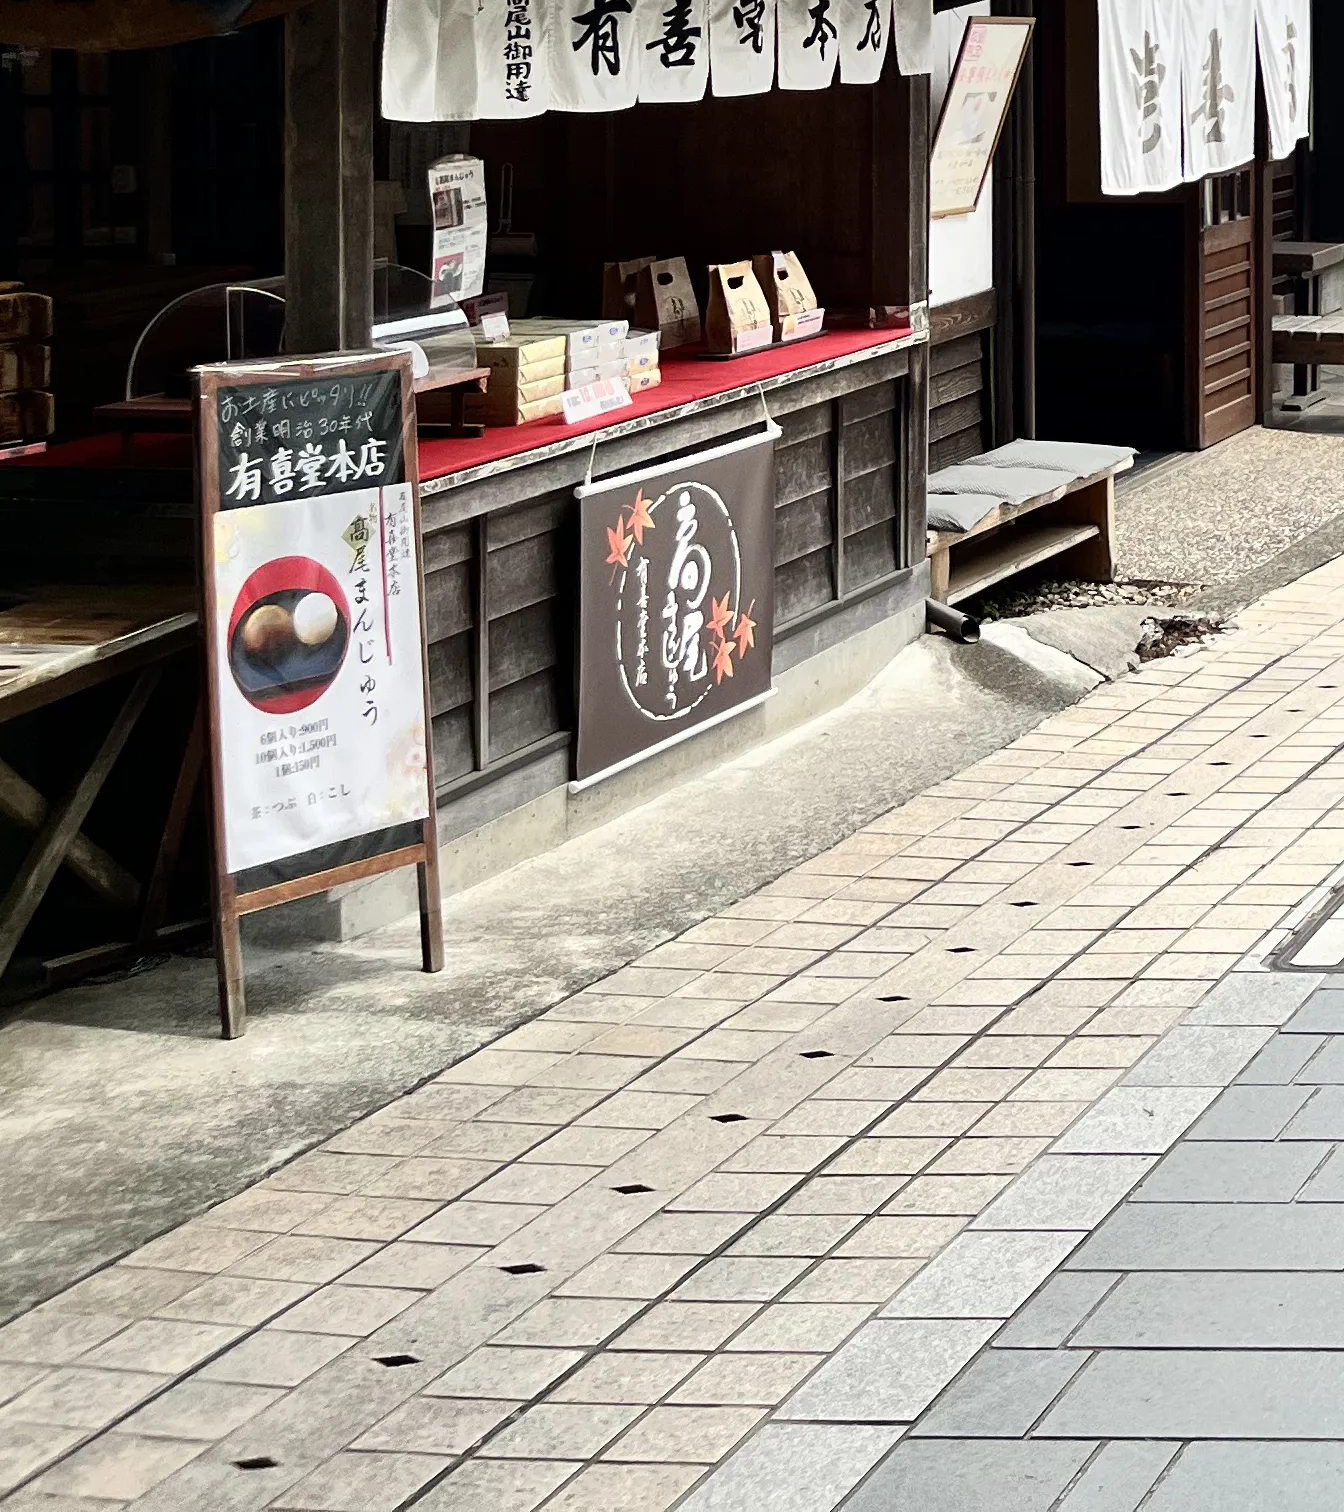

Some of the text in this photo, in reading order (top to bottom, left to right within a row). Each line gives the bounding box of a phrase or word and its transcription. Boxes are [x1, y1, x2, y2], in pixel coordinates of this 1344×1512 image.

[230, 411, 374, 448] 創業明治30年代
[226, 437, 387, 500] 有喜堂本店
